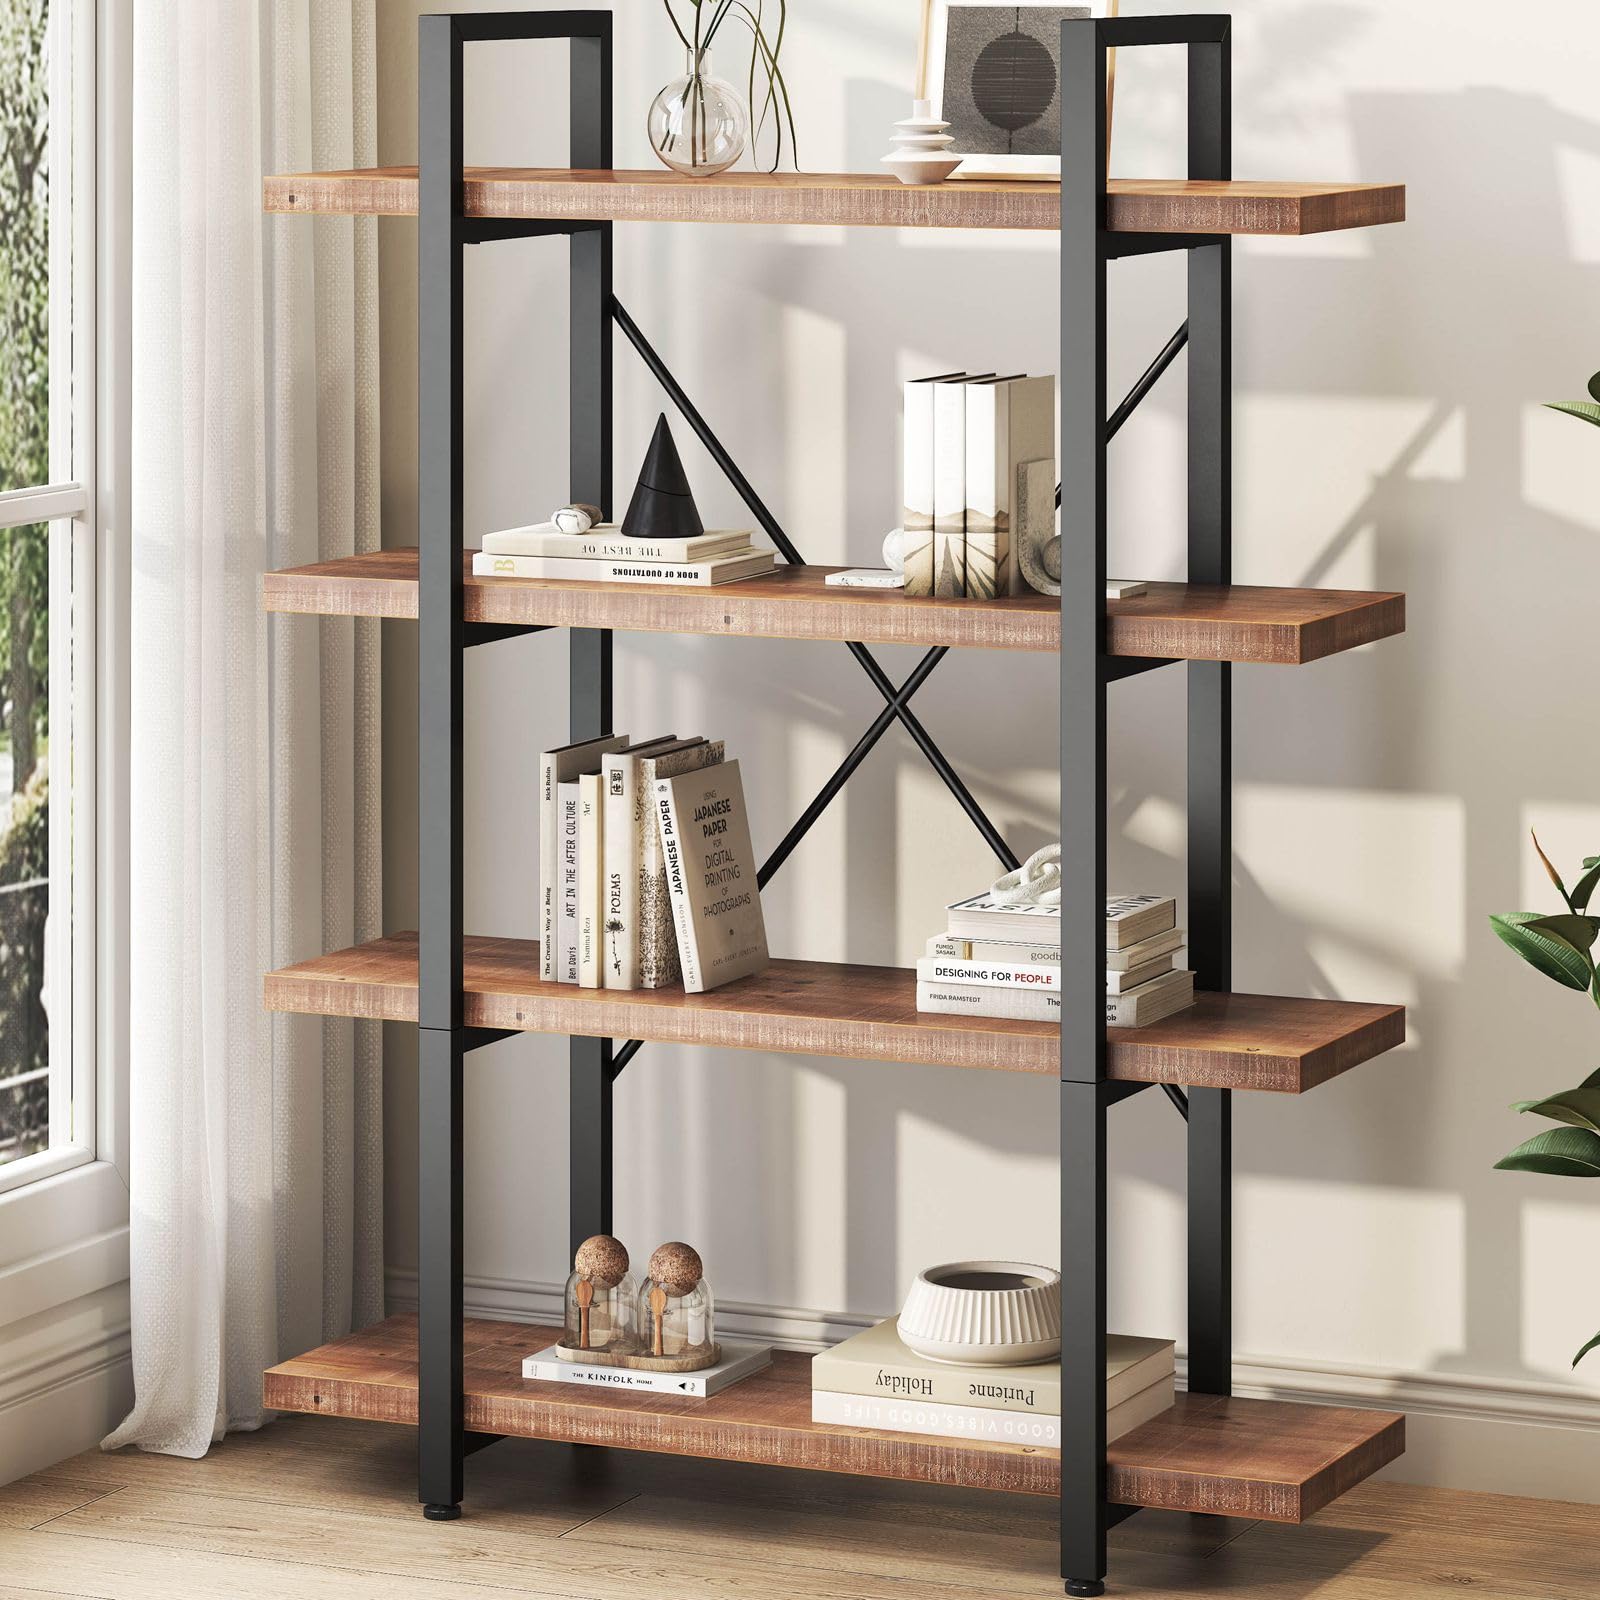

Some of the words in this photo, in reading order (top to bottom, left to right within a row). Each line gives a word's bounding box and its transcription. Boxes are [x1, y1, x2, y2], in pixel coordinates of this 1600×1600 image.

[581, 544, 596, 554] OF
[602, 545, 632, 556] BEST
[638, 547, 663, 557] THE
[612, 567, 662, 577] QUOTATIONS
[664, 570, 674, 578] OF
[677, 571, 699, 579] BOOK
[565, 800, 576, 835] CULTURE
[660, 799, 674, 835] PAPER
[694, 798, 732, 822] JAPANESE
[702, 819, 728, 838] PAPER
[712, 838, 722, 848] FOR
[565, 839, 576, 865] AFTER
[704, 848, 735, 869] DIGITAL
[565, 868, 576, 884] THE
[666, 840, 684, 895] JAPANESE
[704, 865, 741, 888] PRINTING
[565, 888, 576, 898] IN
[610, 873, 621, 914] POEMS
[721, 886, 729, 896] OF
[565, 902, 576, 919] ART
[703, 892, 752, 918] PHOTOGRAPHS
[583, 917, 591, 934] Reza
[566, 946, 577, 966] Davis
[583, 936, 591, 964] Yasmina
[568, 967, 577, 979] Ben
[935, 967, 988, 980] DESIGNING
[991, 971, 1011, 981] FOR
[1014, 973, 1052, 985] PEOPLE
[929, 993, 948, 1001] FRIDA
[948, 994, 981, 1003] RAMSTEDT
[1046, 997, 1061, 1007] The
[587, 1373, 633, 1384] KINFOLK
[875, 1369, 933, 1395] Holiday
[968, 1383, 1035, 1406] Purienne
[843, 1403, 881, 1418] LIFE
[888, 1407, 939, 1426] GOOD
[1003, 1420, 1056, 1440] GOOD
